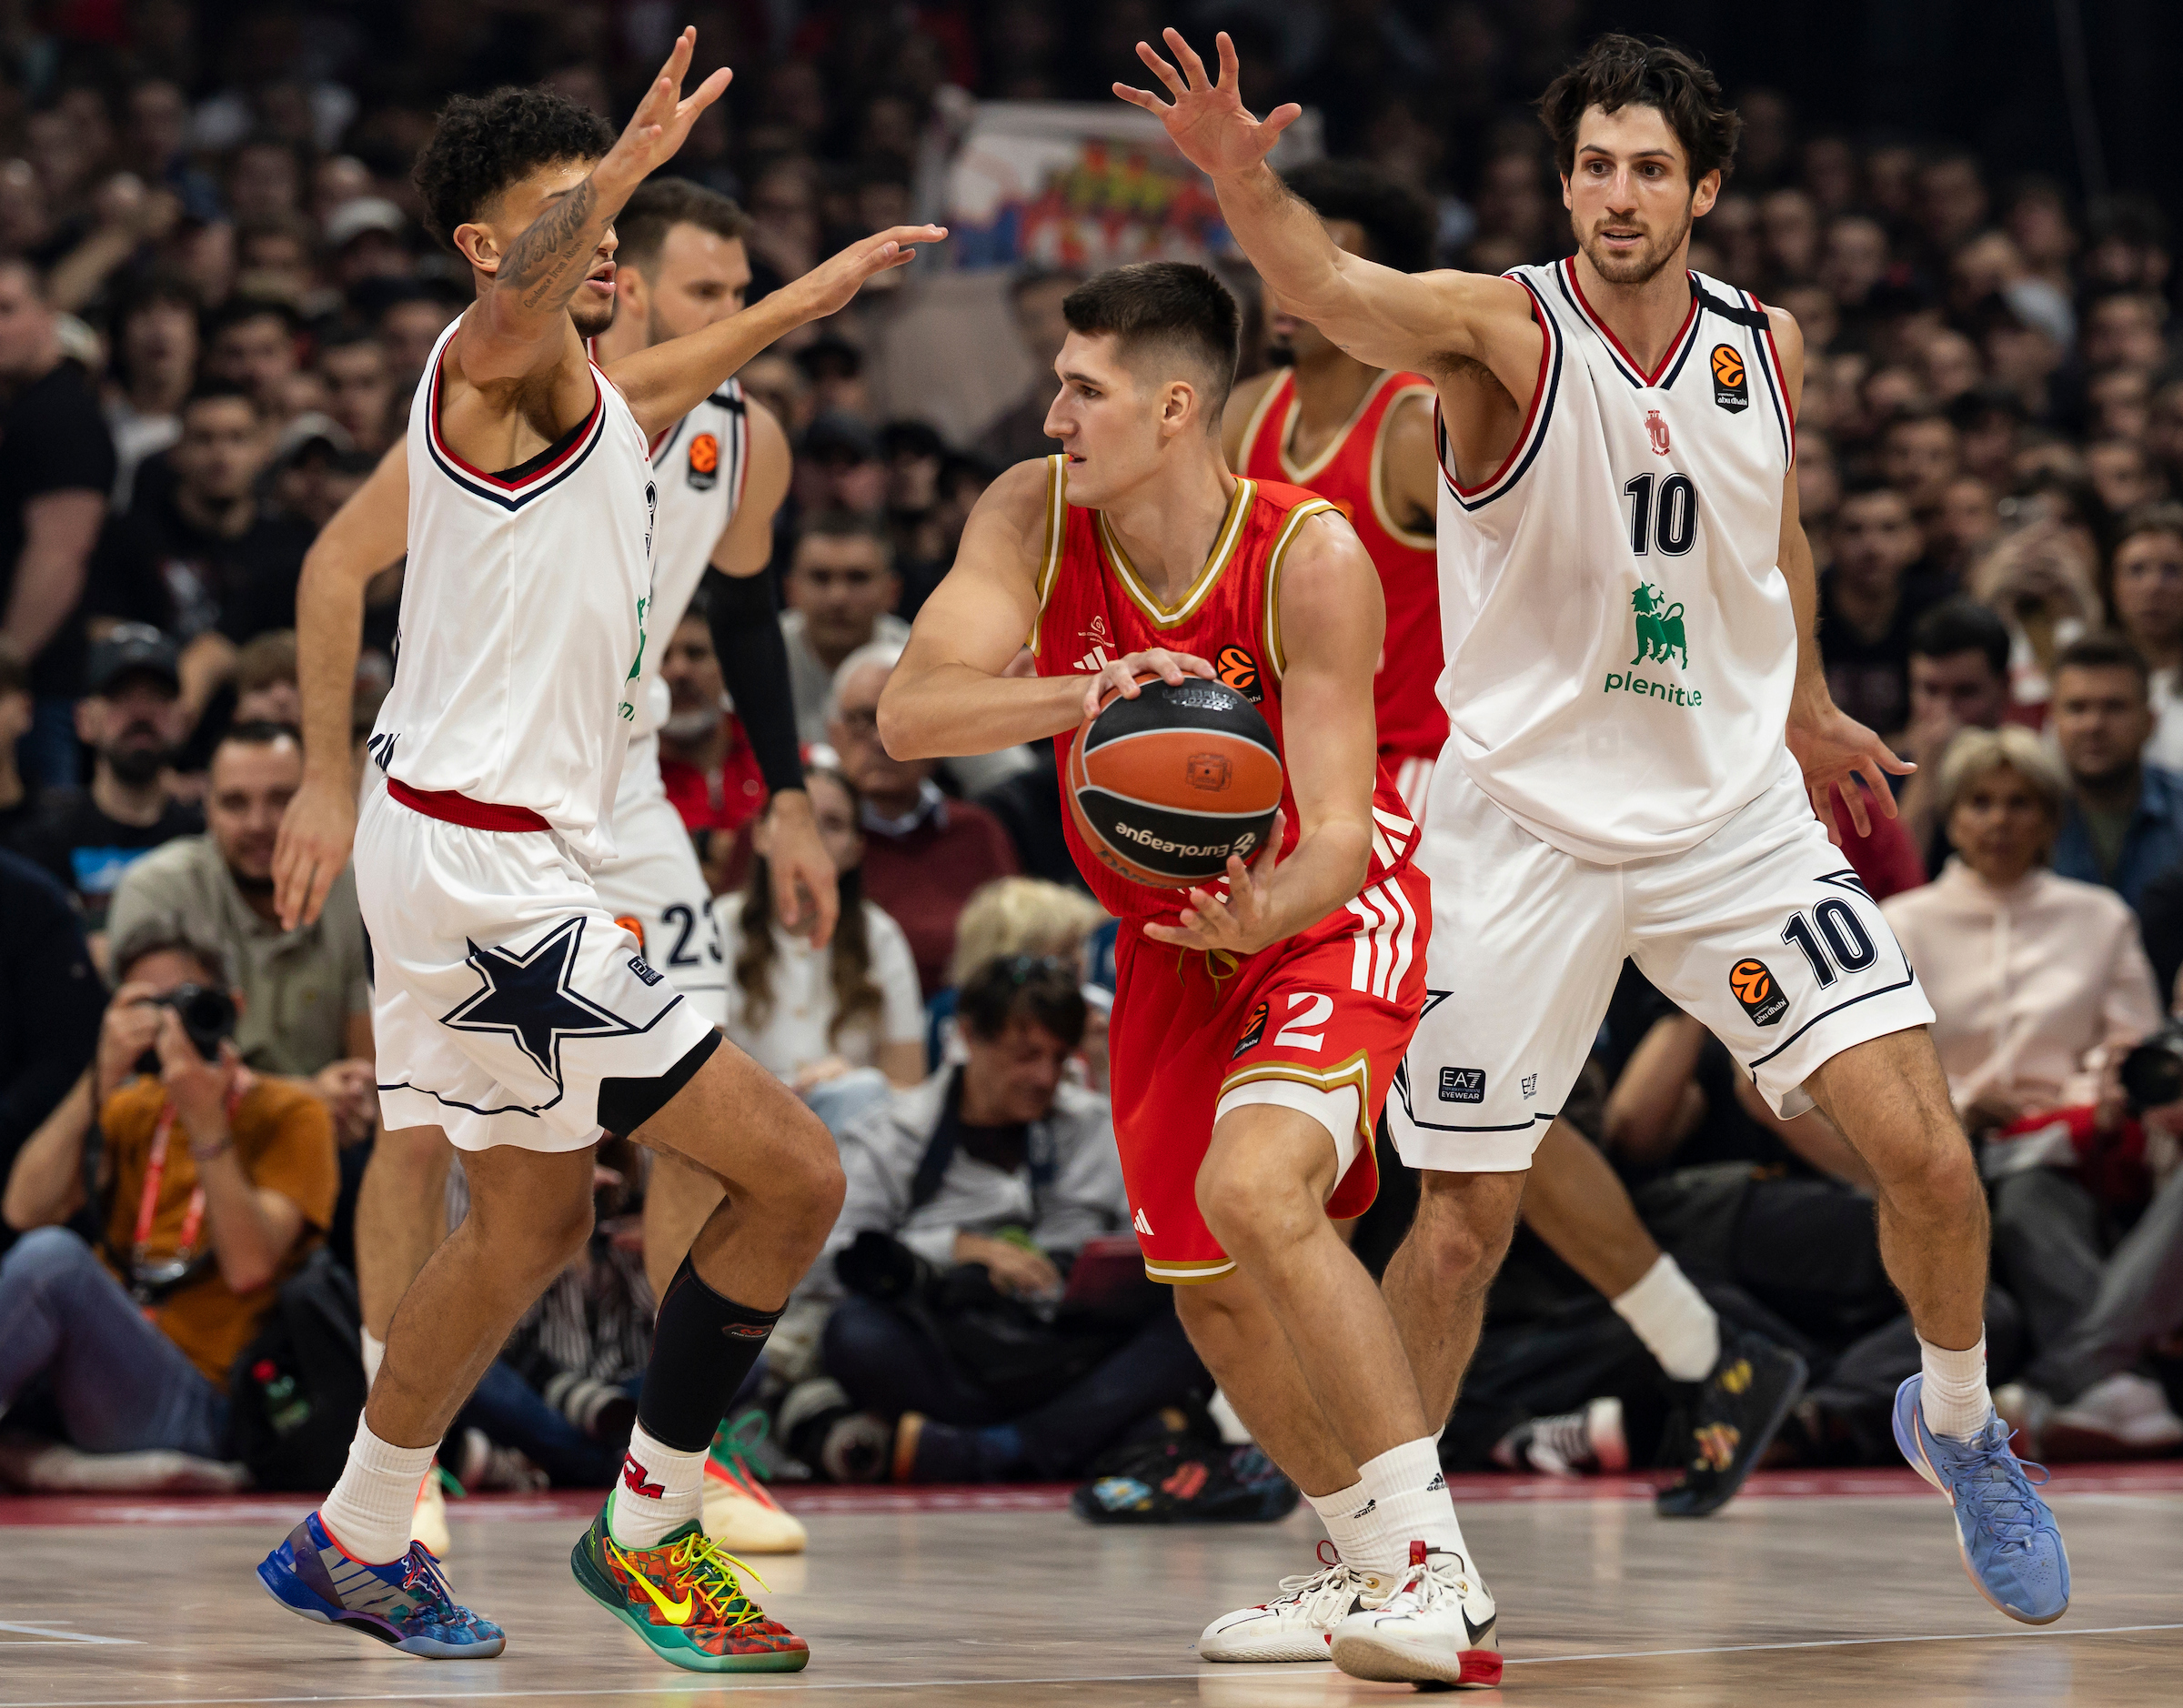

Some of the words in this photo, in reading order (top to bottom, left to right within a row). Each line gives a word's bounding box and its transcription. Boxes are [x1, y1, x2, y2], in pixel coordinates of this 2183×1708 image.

[1717, 396, 1731, 405] abu
[1731, 397, 1747, 407] dhabi
[1624, 471, 1699, 557] 10
[1115, 821, 1230, 859] EuroLeague
[1780, 896, 1878, 990] 10
[1273, 991, 1334, 1052] 2
[1755, 1012, 1769, 1024] abu
[1766, 998, 1787, 1016] dhabi
[1441, 1090, 1481, 1100] EYEWEAR
[1443, 1070, 1482, 1089] EA7
